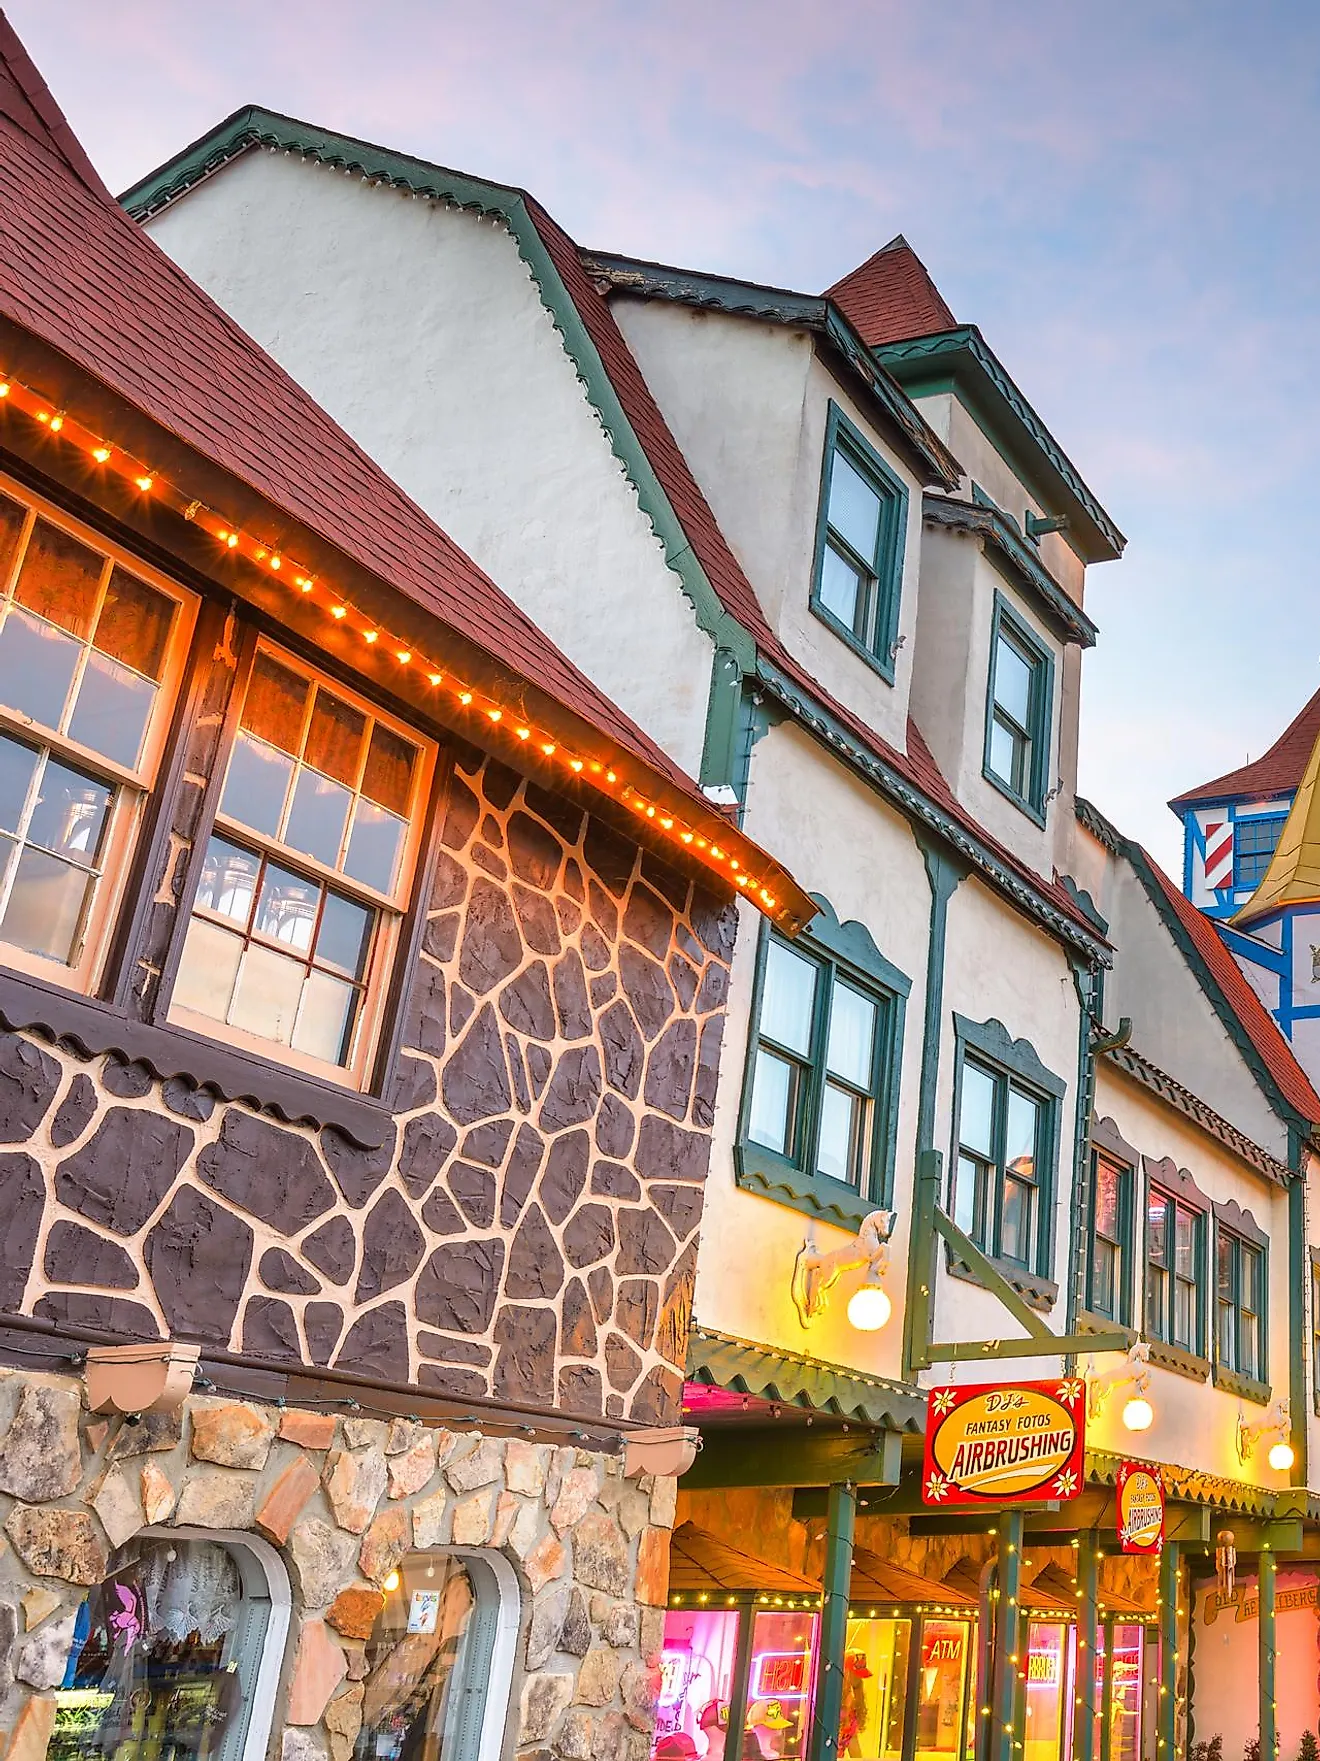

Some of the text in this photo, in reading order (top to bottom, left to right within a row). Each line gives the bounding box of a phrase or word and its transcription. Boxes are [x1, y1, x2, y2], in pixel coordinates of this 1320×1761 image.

[966, 1414, 1051, 1435] FANTASY FOTOS
[950, 1431, 1071, 1479] AIRBRUSHING
[930, 1640, 961, 1661] ATM
